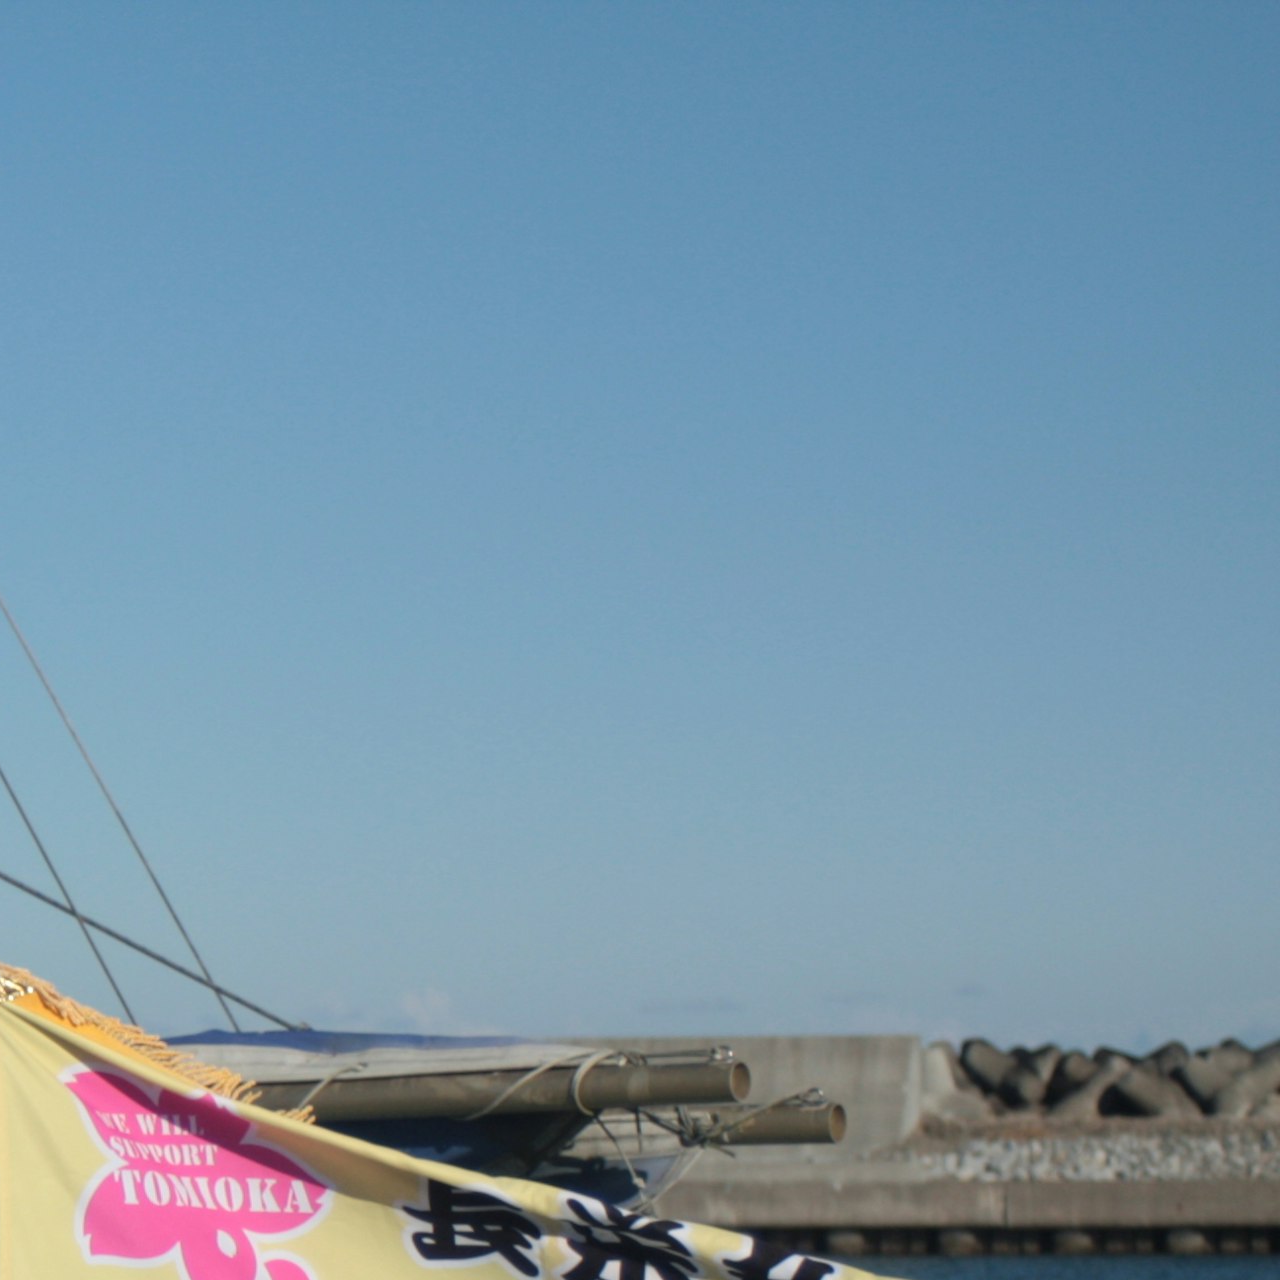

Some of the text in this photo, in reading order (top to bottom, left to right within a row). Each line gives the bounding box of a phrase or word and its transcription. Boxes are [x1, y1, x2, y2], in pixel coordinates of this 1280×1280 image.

[96, 1110, 205, 1136] WE WILL
[109, 1136, 218, 1166] SUPPORT
[113, 1169, 315, 1214] TOMIOKA
